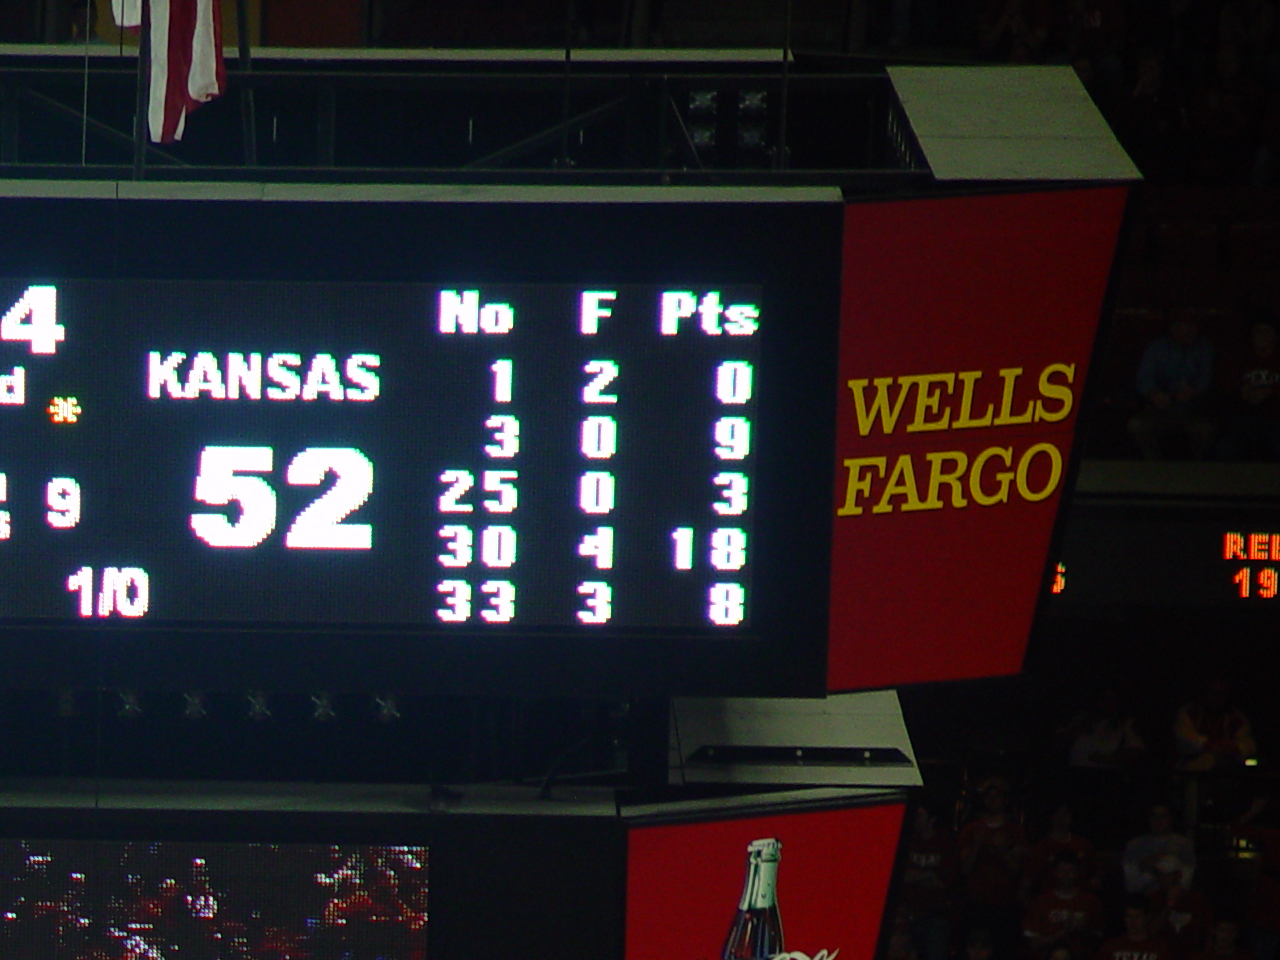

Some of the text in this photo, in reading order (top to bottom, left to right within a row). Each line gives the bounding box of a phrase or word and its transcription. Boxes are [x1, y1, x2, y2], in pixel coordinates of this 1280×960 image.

[439, 290, 760, 335] No F Pts
[147, 351, 381, 401] KANSAS
[492, 359, 753, 404] 1 2 0
[849, 362, 1076, 436] WELLS
[485, 415, 751, 460] 3 0 9
[48, 477, 80, 527] 9
[191, 445, 373, 548] 52
[439, 470, 749, 515] 25 0 3
[837, 442, 1063, 517] FARGO
[439, 525, 747, 570] 30 4 18
[68, 566, 149, 616] 1/0
[437, 579, 745, 625] 33 3 8
